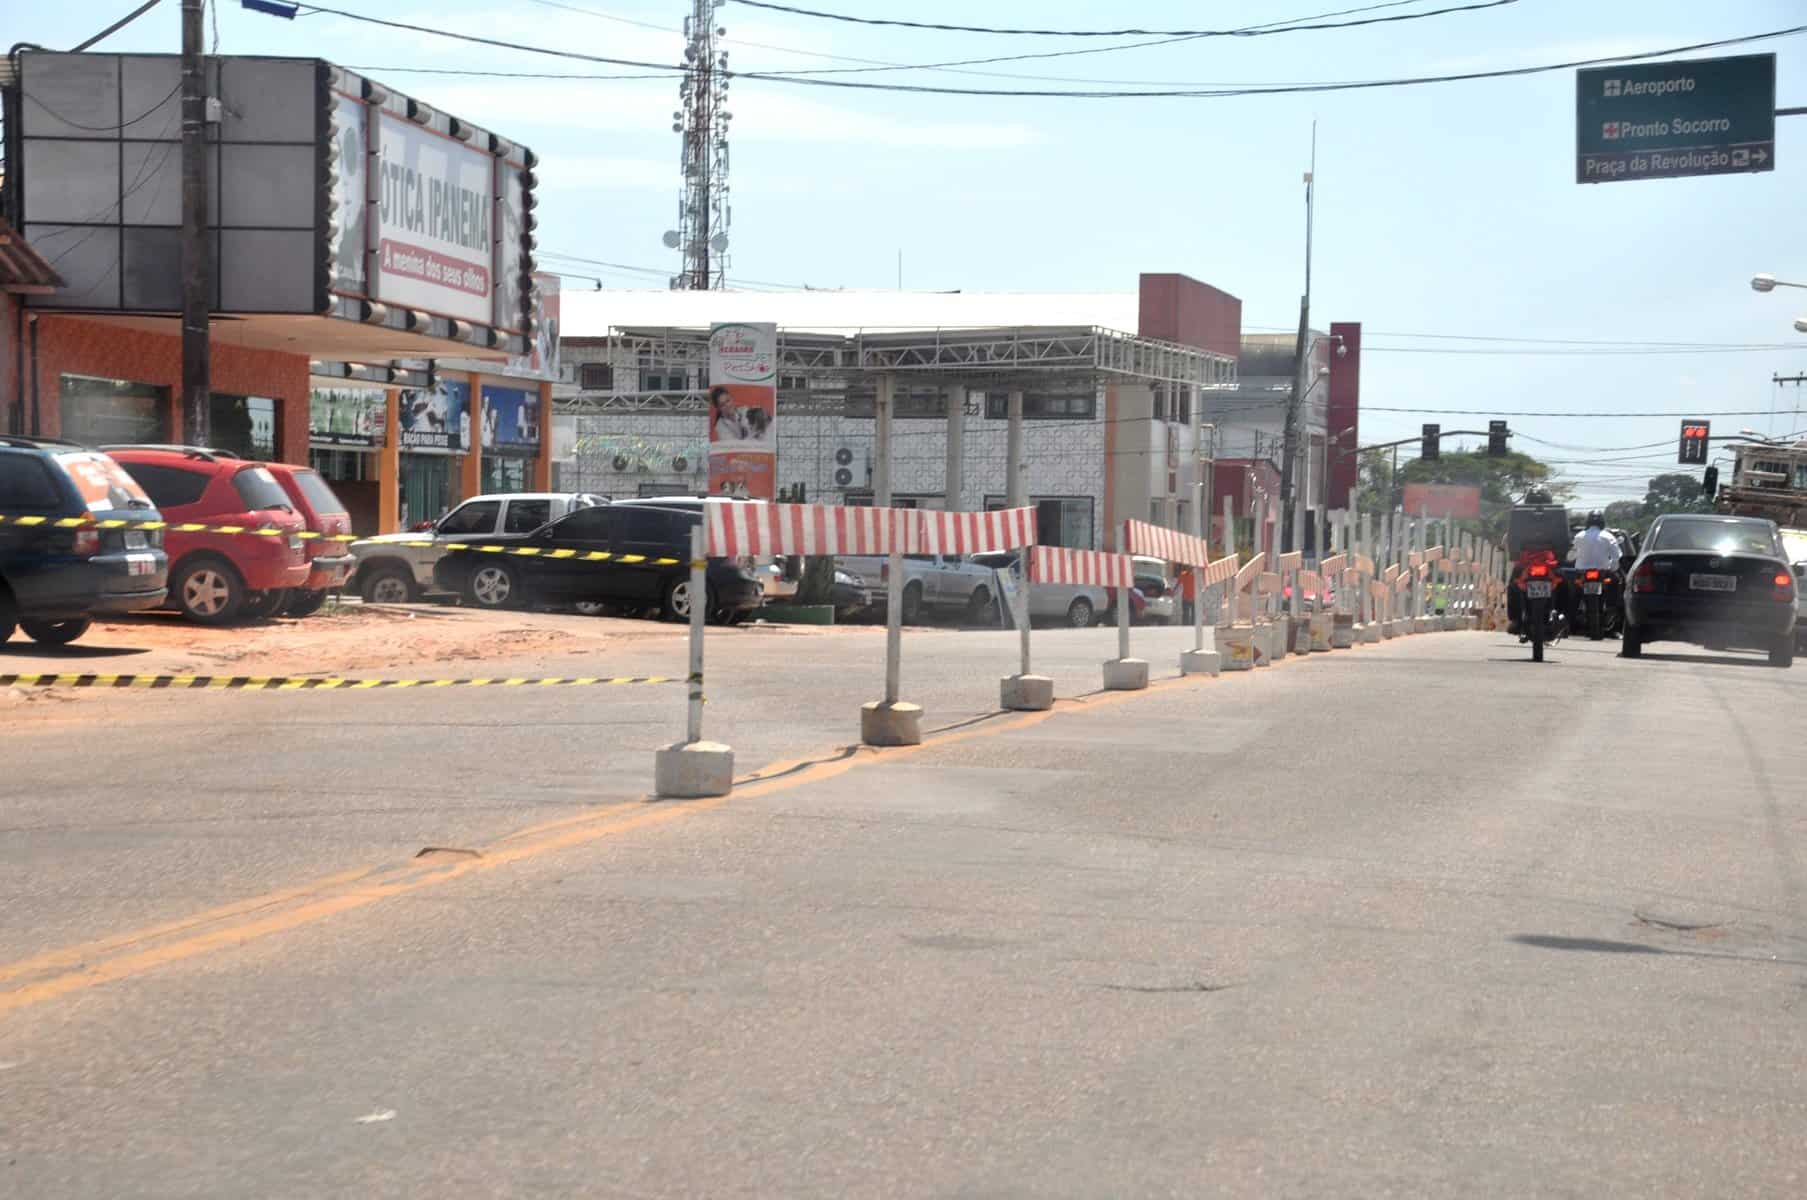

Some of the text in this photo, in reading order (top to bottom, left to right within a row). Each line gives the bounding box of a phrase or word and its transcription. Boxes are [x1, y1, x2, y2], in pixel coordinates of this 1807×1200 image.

[1623, 77, 1696, 97] Aeroporto
[1621, 118, 1730, 138] Pronto Socorro
[1586, 151, 1729, 177] Praça da Revolução
[380, 144, 489, 253] ÓTICA IPANEMA
[383, 243, 486, 292] A menina dos seus olhos
